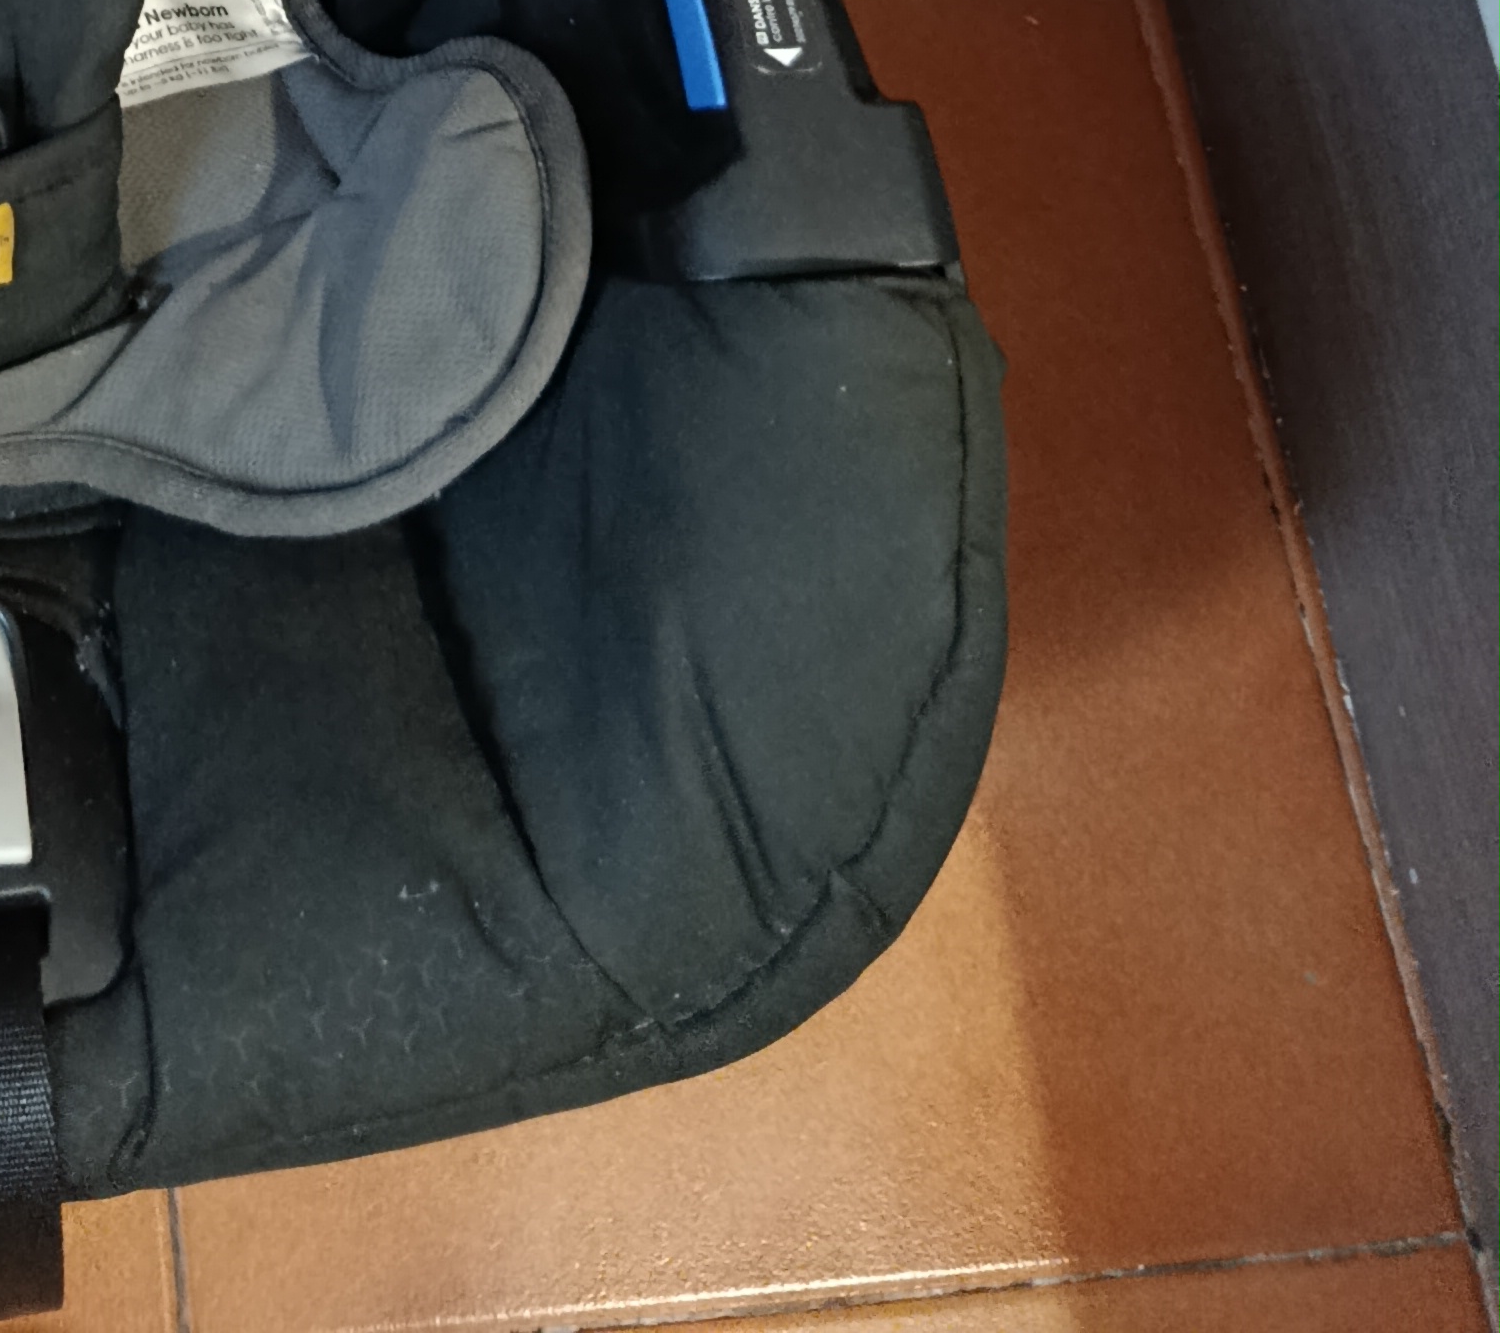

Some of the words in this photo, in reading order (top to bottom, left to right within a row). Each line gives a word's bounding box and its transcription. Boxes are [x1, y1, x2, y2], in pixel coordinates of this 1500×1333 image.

[143, 2, 229, 26] Newborn
[764, 4, 783, 43] contre
[133, 28, 163, 50] your
[166, 20, 206, 36] baby
[207, 20, 236, 31] has
[181, 36, 195, 49] is
[196, 34, 223, 45] too
[223, 29, 258, 42] tight
